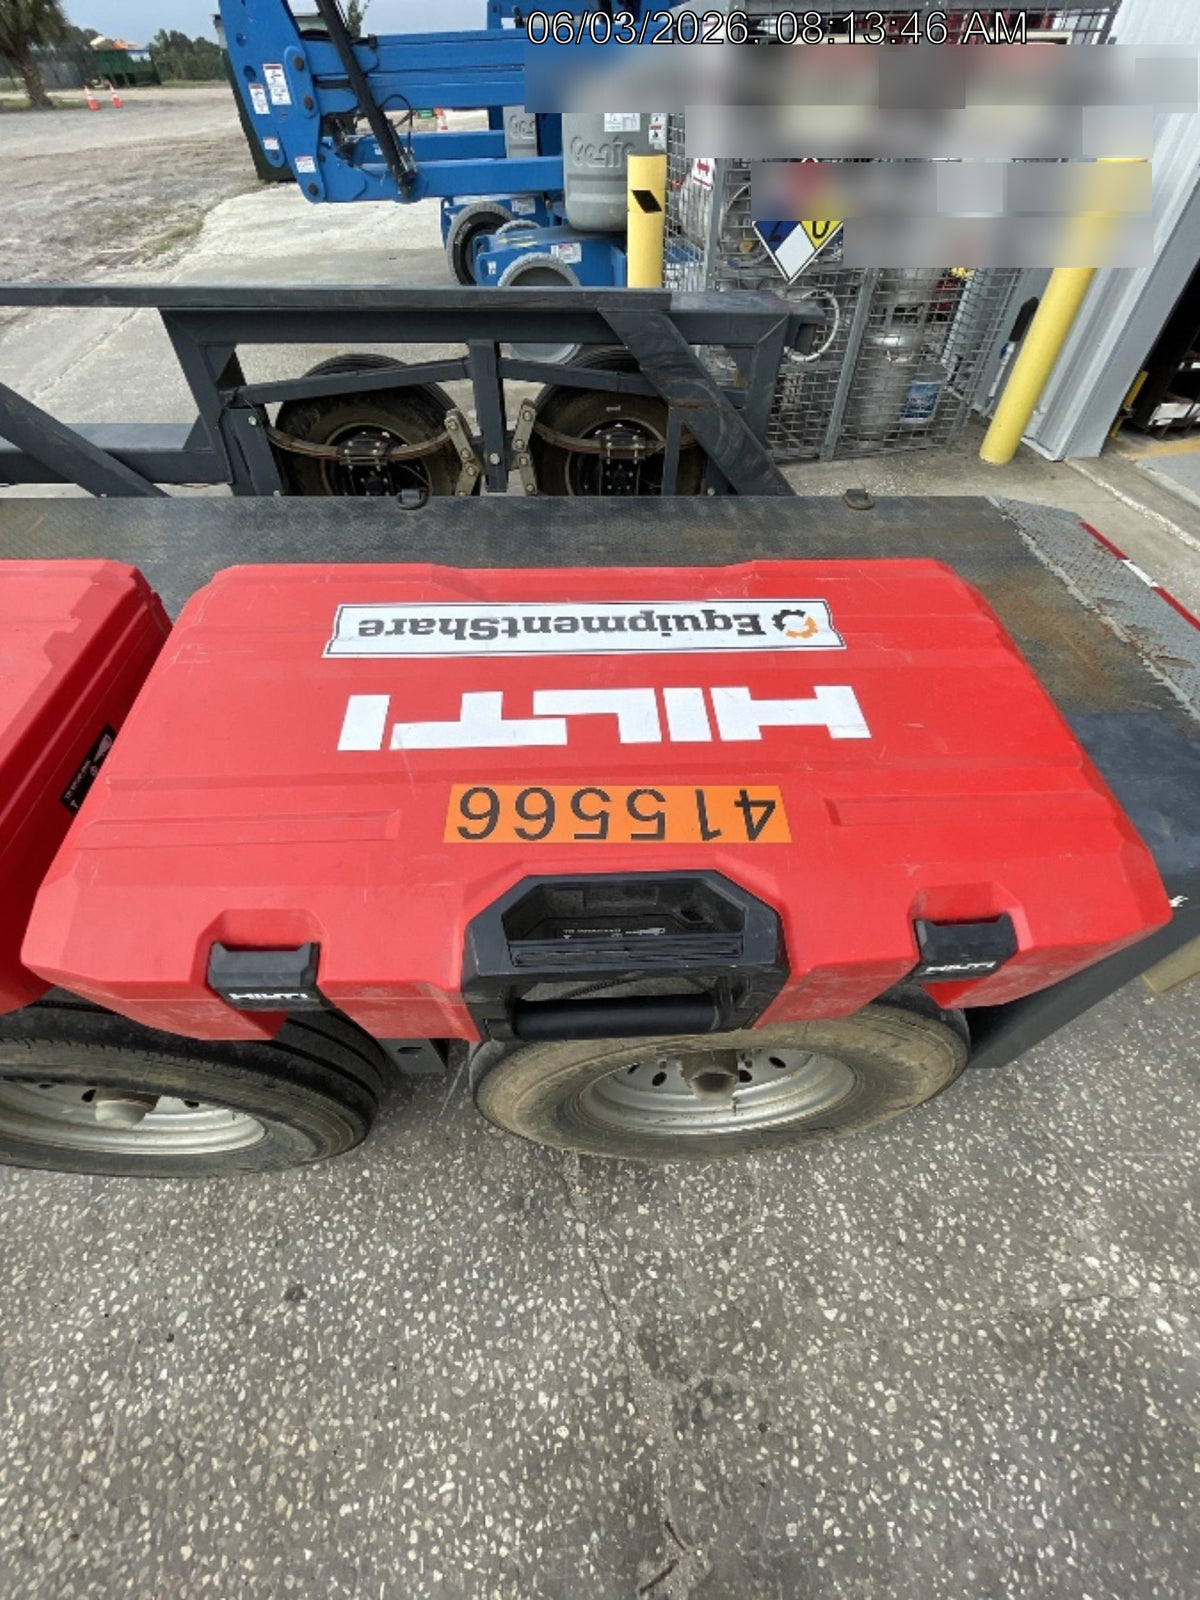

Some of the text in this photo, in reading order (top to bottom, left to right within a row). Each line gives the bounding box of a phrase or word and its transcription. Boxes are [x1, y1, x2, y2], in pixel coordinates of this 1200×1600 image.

[357, 608, 767, 642] EquipmentShare
[337, 685, 873, 752] HILTI
[456, 786, 777, 842] 415566
